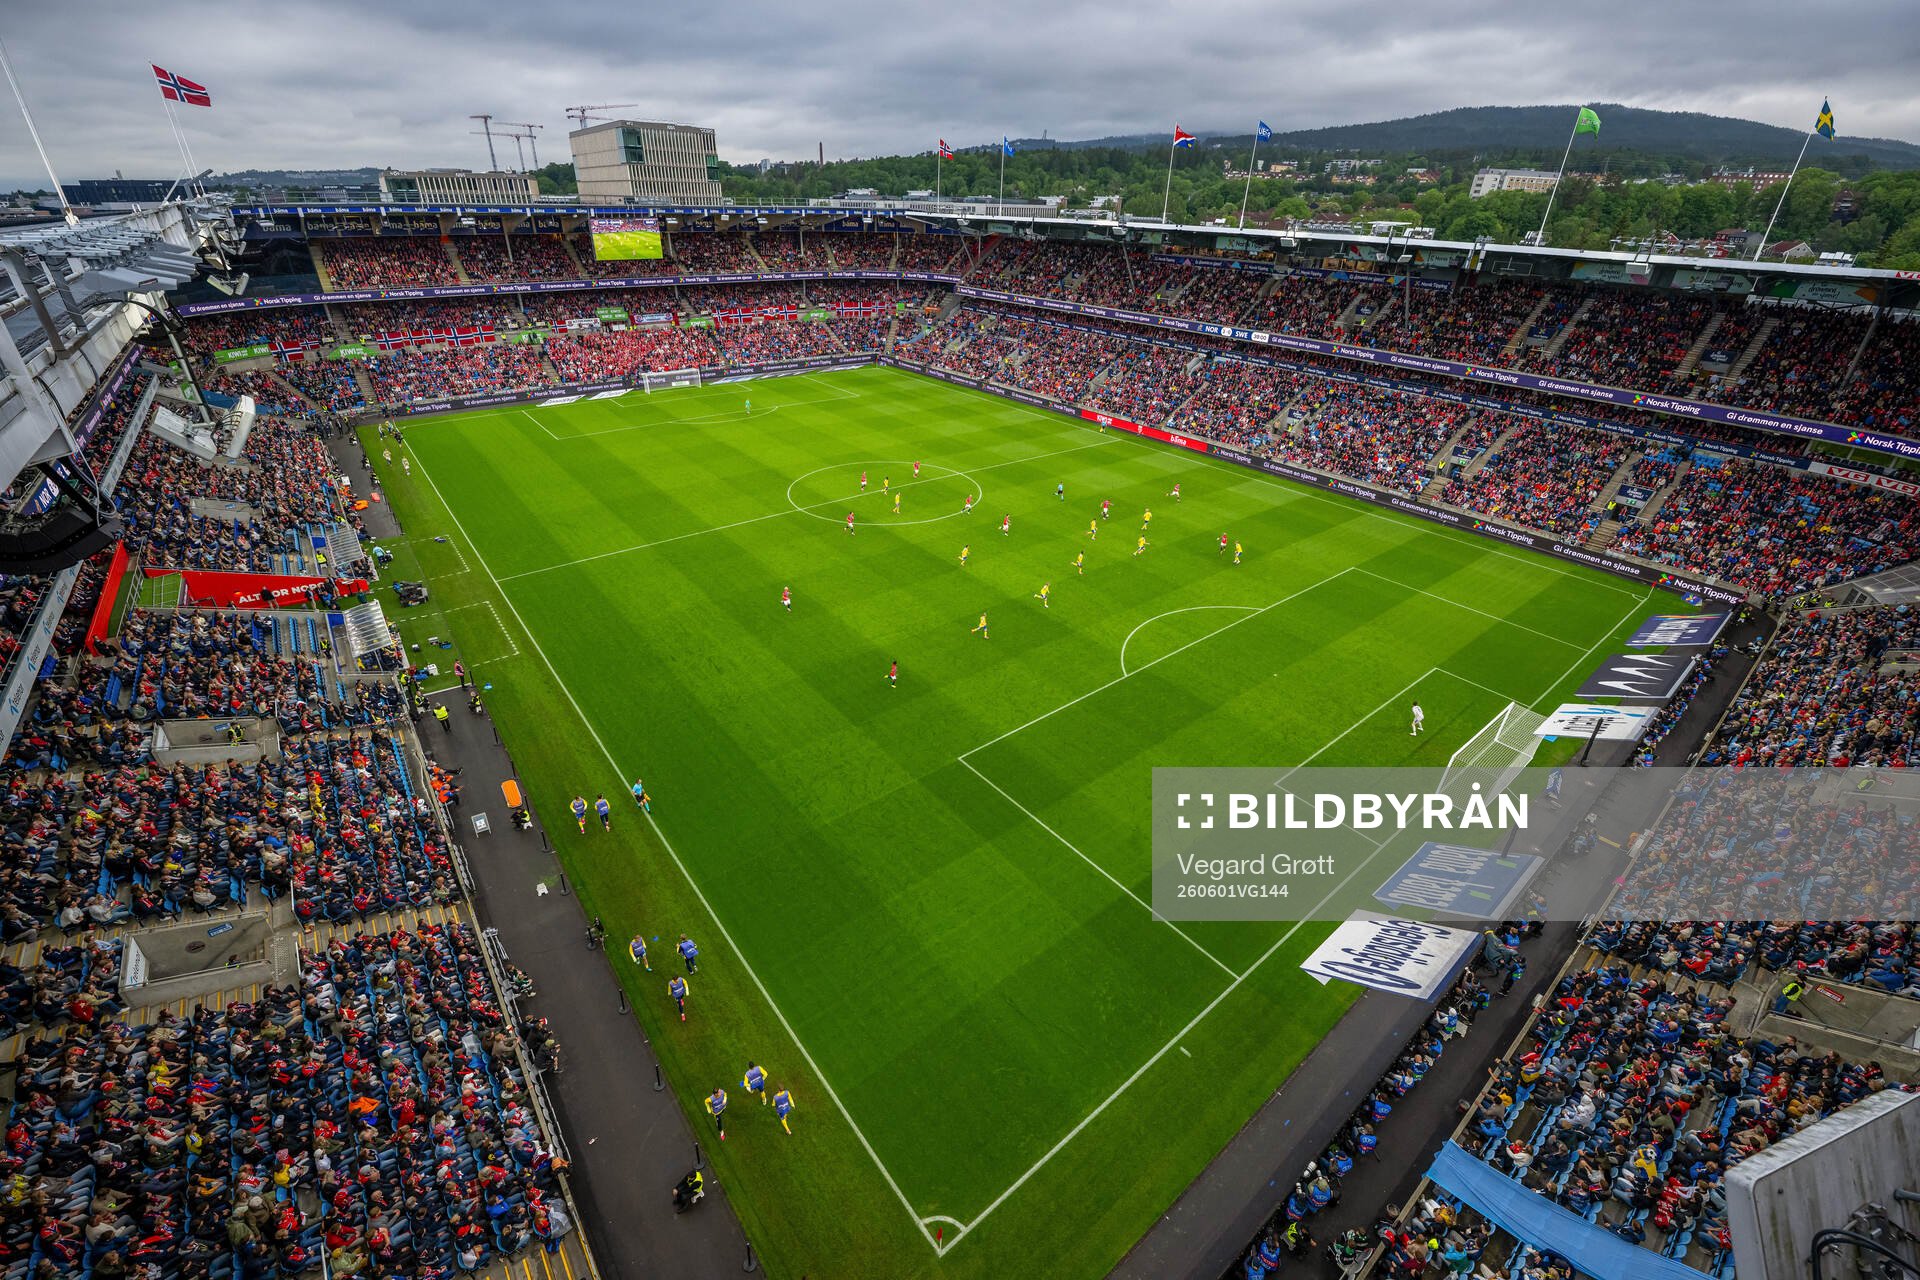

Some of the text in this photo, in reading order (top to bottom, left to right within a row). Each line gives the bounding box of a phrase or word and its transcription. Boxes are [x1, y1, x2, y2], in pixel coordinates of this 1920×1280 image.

[1356, 350, 1374, 359] Tipping
[1495, 373, 1518, 383] Tipping
[1548, 382, 1580, 393] drømmen
[1592, 389, 1613, 398] sjanse
[1647, 398, 1700, 414] Norsk Tipping
[1727, 412, 1736, 421] Gi
[1738, 414, 1779, 427] drømmen
[1795, 423, 1822, 434] sjanse
[1720, 445, 1738, 454] Tipping
[1864, 436, 1894, 449] Norsk
[1221, 450, 1251, 463] Norsk Tipping
[1776, 455, 1795, 465] Tipping
[1828, 466, 1918, 494] VG VG
[1338, 483, 1375, 498] Norsk Tipping
[1400, 500, 1428, 514] drømmen
[1439, 511, 1458, 522] sjanse
[1485, 525, 1534, 544] Norsk Tipping
[1554, 544, 1640, 574] Gi drømmen en sjanse
[239, 593, 261, 604] ALT
[1674, 579, 1738, 604] Norsk Tipping
[1341, 920, 1452, 971] Gjensidige
